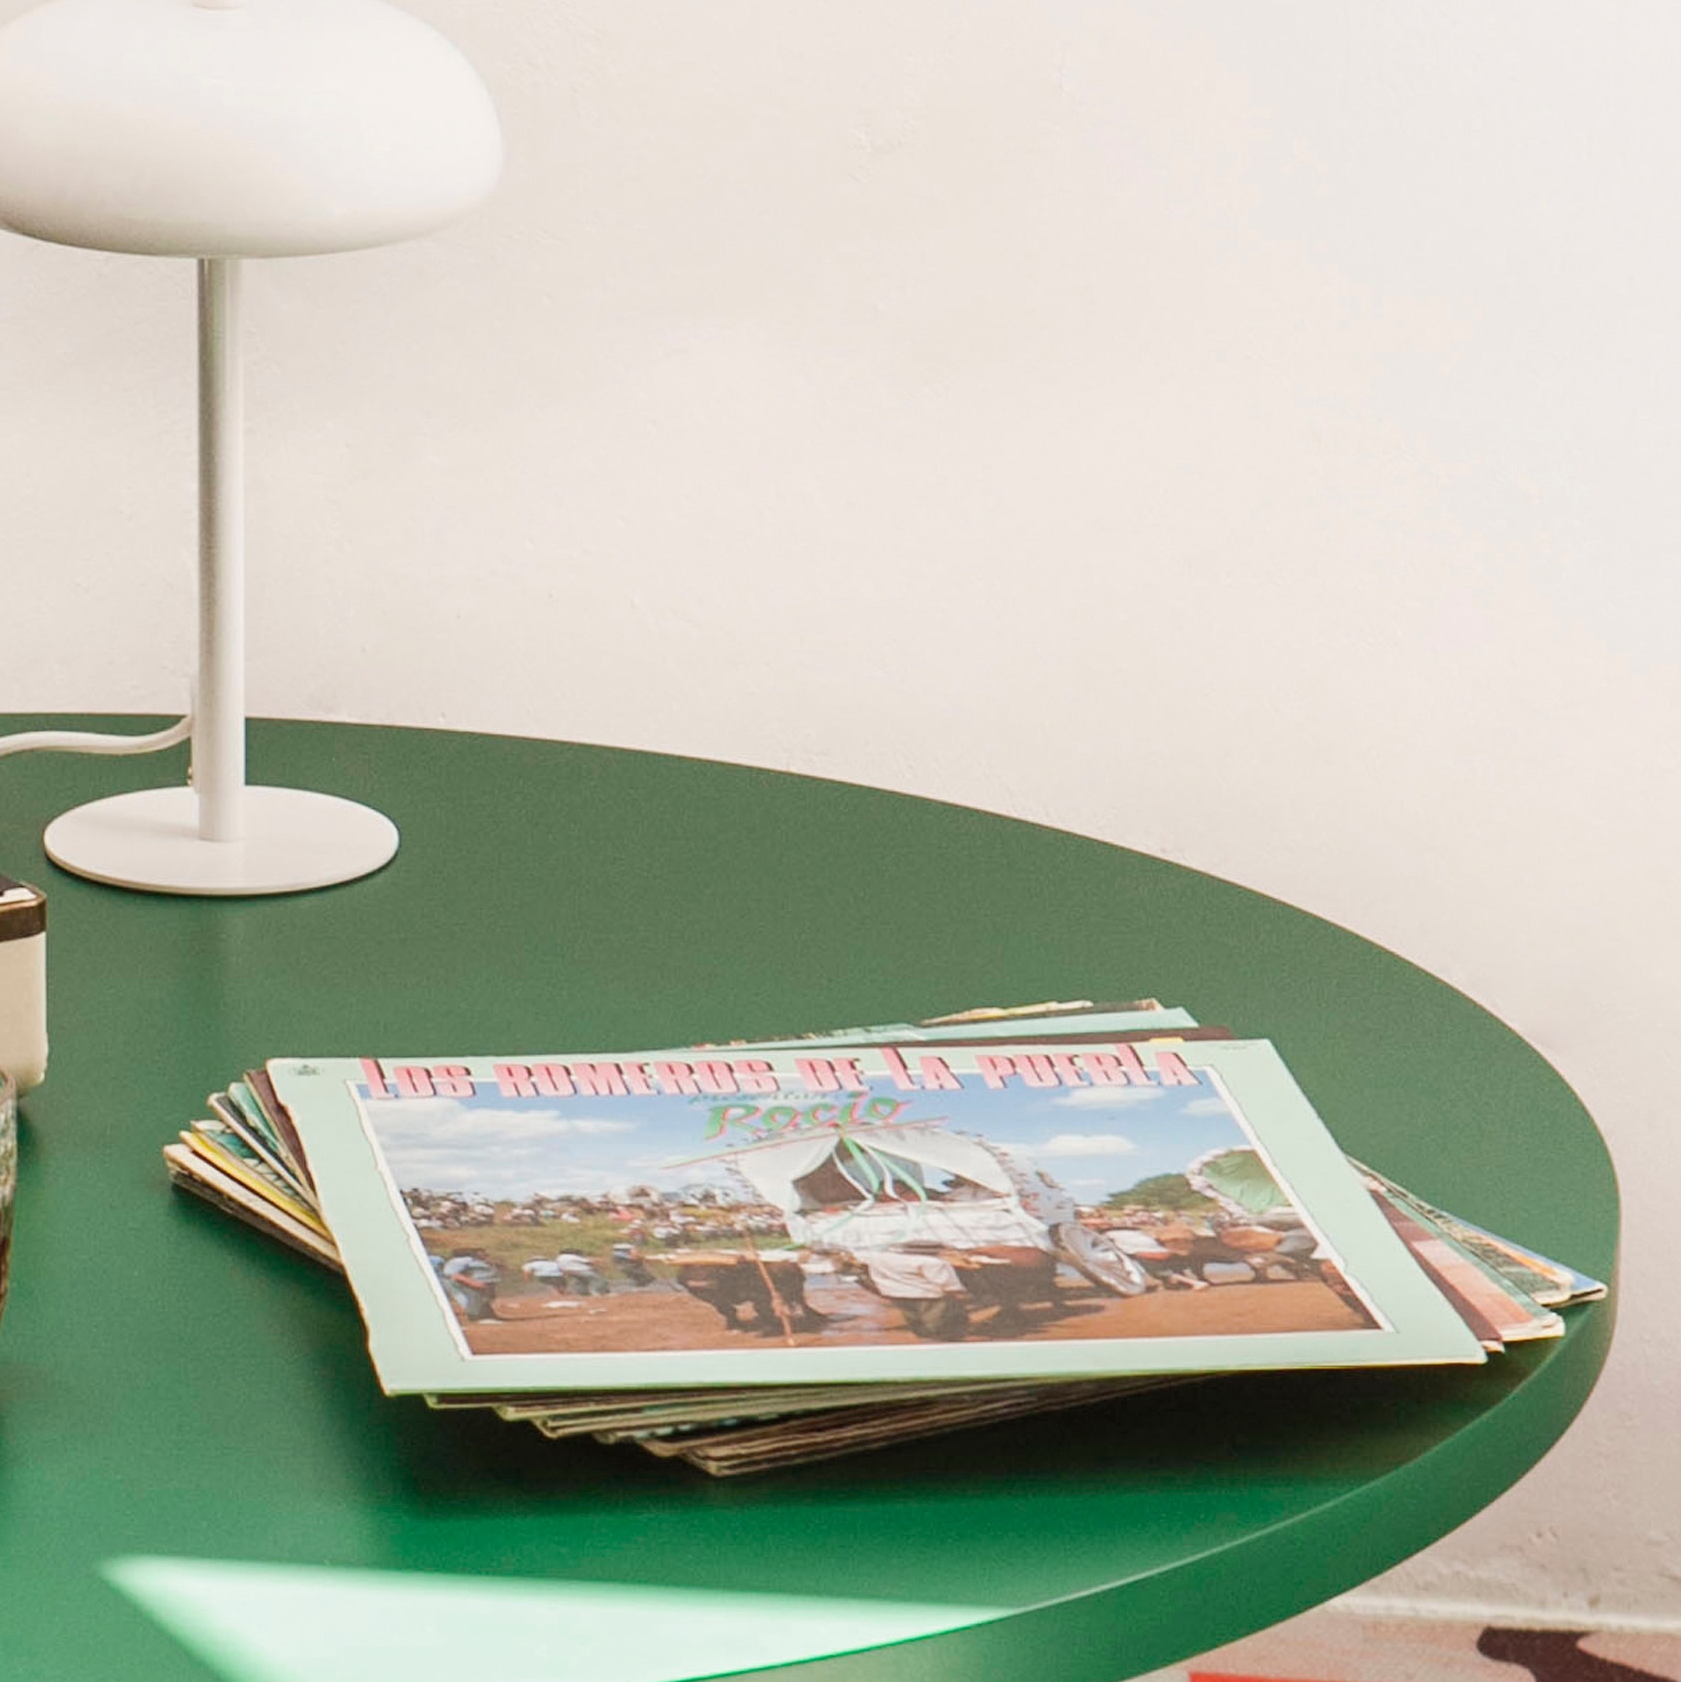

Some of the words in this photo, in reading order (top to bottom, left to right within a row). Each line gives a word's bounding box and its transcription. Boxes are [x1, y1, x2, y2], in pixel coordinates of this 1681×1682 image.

[493, 1058, 781, 1097] ROMEROS
[795, 1057, 870, 1093] DE
[879, 1046, 964, 1091] LA
[975, 1043, 1202, 1089] PUEBLA
